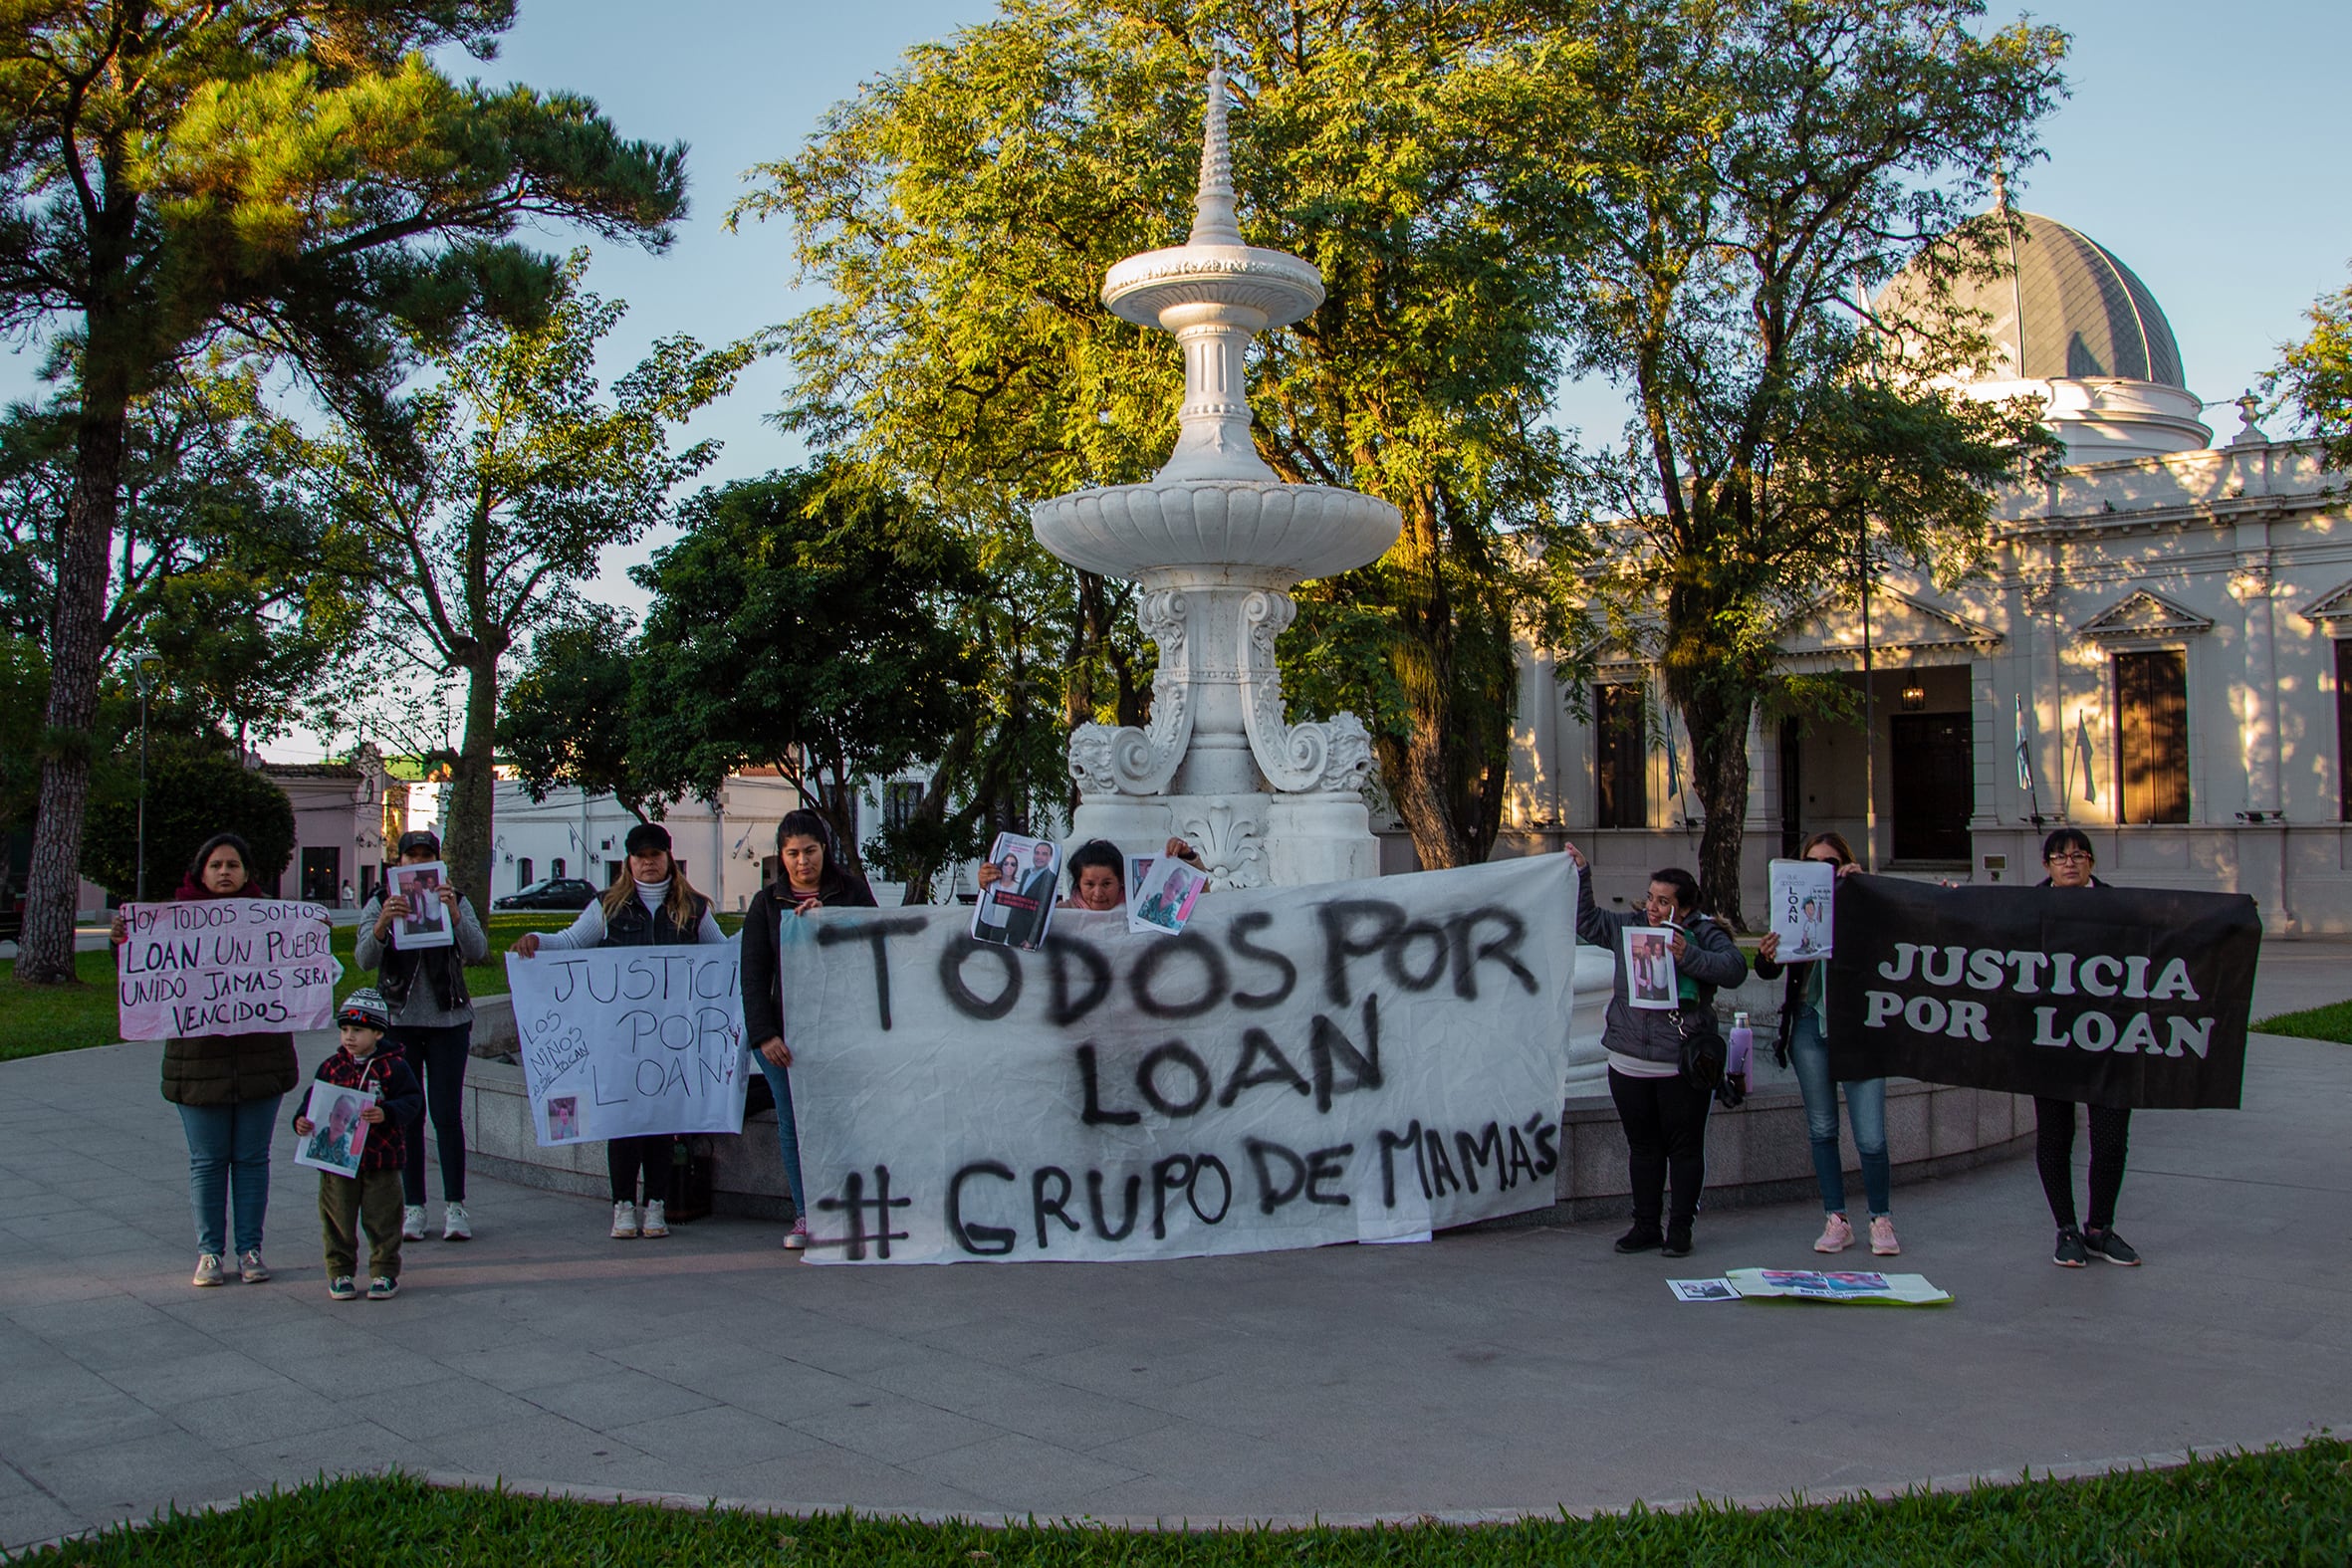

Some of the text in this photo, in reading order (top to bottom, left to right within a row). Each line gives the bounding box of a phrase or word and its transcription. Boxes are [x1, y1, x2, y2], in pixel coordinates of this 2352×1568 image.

[167, 903, 237, 931] TODOS
[249, 903, 329, 924] SOMOS
[1787, 886, 1798, 923] LOAN
[215, 934, 251, 966] UN
[816, 898, 1540, 1030] TODOS POR
[1878, 942, 2201, 1002] JUSTICIA
[120, 967, 329, 1007] UNIDO JAMAS SERA
[549, 955, 741, 1004] JUSTICI
[521, 1008, 562, 1045] LOS
[615, 1007, 731, 1053] POR
[1864, 990, 2216, 1059] POR LOAN
[530, 1026, 583, 1077] NIÑOS
[1075, 992, 1385, 1125] LOAN
[591, 1054, 724, 1106] LOAN
[949, 1153, 1234, 1256] GRUPO
[1244, 1137, 1355, 1215] DE
